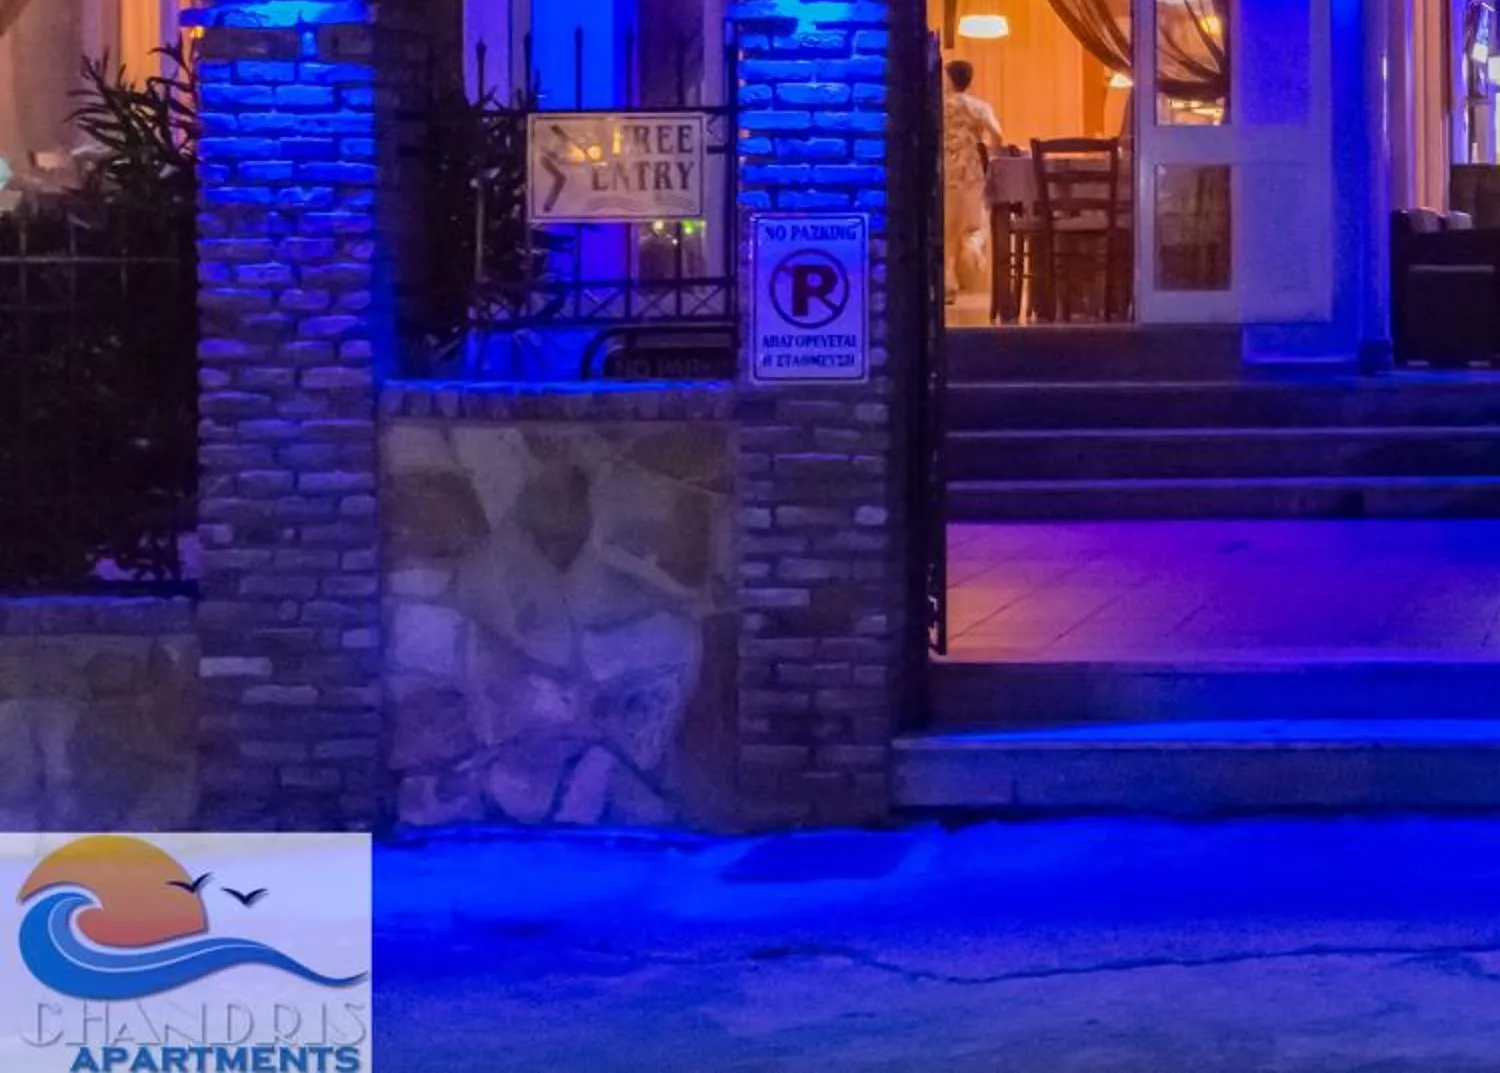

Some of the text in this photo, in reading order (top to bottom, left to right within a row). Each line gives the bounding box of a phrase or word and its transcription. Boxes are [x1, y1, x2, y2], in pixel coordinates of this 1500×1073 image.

[611, 124, 694, 155] REE
[591, 160, 694, 192] ENTRY
[764, 224, 787, 241] NO
